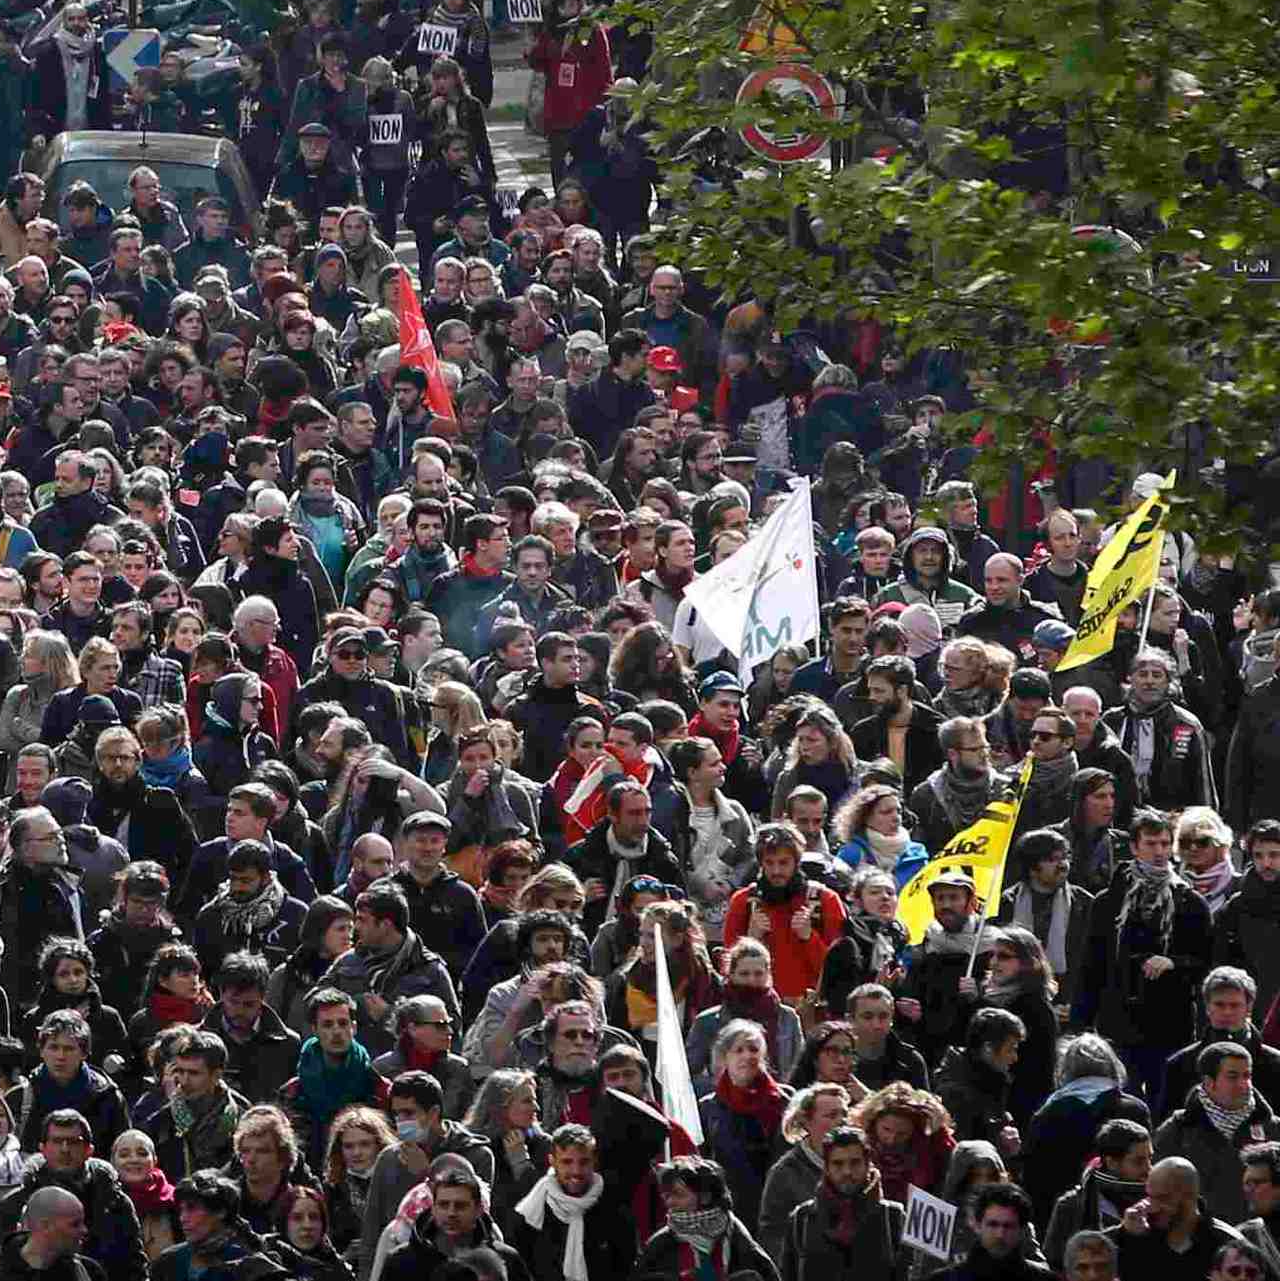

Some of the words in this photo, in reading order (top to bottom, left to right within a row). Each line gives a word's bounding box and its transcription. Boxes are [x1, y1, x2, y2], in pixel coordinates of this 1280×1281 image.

[509, 1, 540, 19] NON
[420, 28, 457, 53] NON
[371, 121, 402, 141] NON
[907, 1197, 952, 1252] NON
